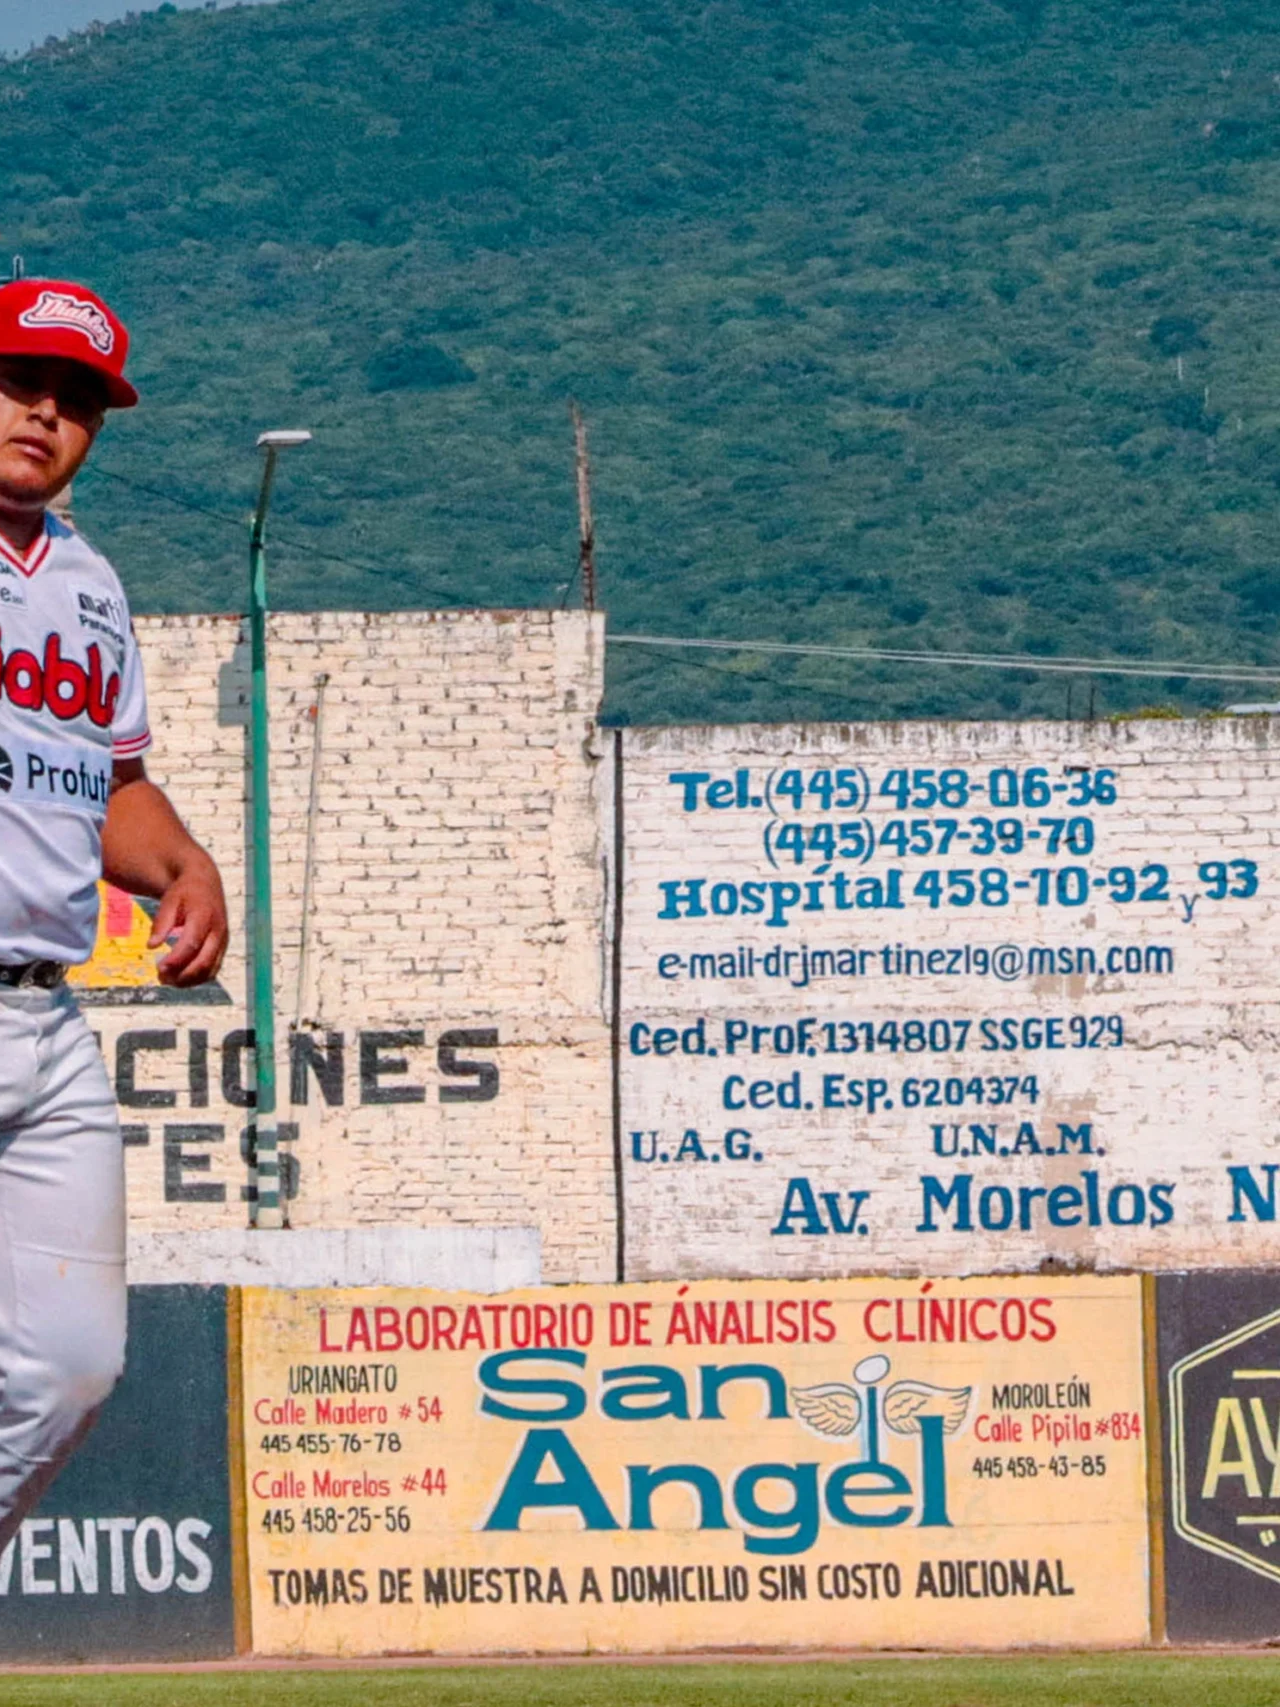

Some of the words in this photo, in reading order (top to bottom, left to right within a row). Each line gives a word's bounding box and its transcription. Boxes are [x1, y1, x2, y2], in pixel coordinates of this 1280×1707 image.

[27, 752, 108, 804] Profut
[880, 767, 1117, 810] 458-06-36
[914, 864, 1169, 908] 458-10-92
[1198, 859, 1259, 900] 93
[629, 1018, 718, 1056] Ced.
[723, 1071, 814, 1111] Ced.
[901, 1075, 1040, 1108] 6204374
[629, 1128, 763, 1163] U.A.G.
[930, 1122, 1106, 1158] U.N.A.M.
[771, 1177, 870, 1235] Av.
[916, 1171, 1176, 1229] Morelos
[320, 1302, 593, 1352] LABORATORIO
[609, 1302, 652, 1345] DE
[665, 1285, 837, 1346] ÁNALISIS
[863, 1281, 1057, 1343] CLÍNICOS
[289, 1364, 398, 1394] URIANGATO
[477, 1347, 796, 1421] San
[992, 1375, 1091, 1410] MOROLEÓN
[254, 1398, 306, 1425] Calle
[315, 1397, 388, 1425] Madero
[974, 1414, 1022, 1442] Calle
[260, 1434, 291, 1454] 445
[252, 1471, 306, 1499] Calle
[313, 1469, 391, 1499] Morelos
[477, 1415, 955, 1555] Angel
[972, 1457, 1003, 1478] 445
[262, 1509, 295, 1533] 445
[302, 1506, 411, 1533] 458-25-56
[268, 1568, 369, 1606] TOMAS
[378, 1568, 413, 1604] DE
[423, 1566, 568, 1607] MUESTRA
[579, 1566, 603, 1604] A
[612, 1565, 748, 1606] DOMICILIO
[759, 1564, 808, 1602] SIN
[818, 1562, 901, 1600] COSTO
[915, 1559, 1075, 1599] ADICIONAL
